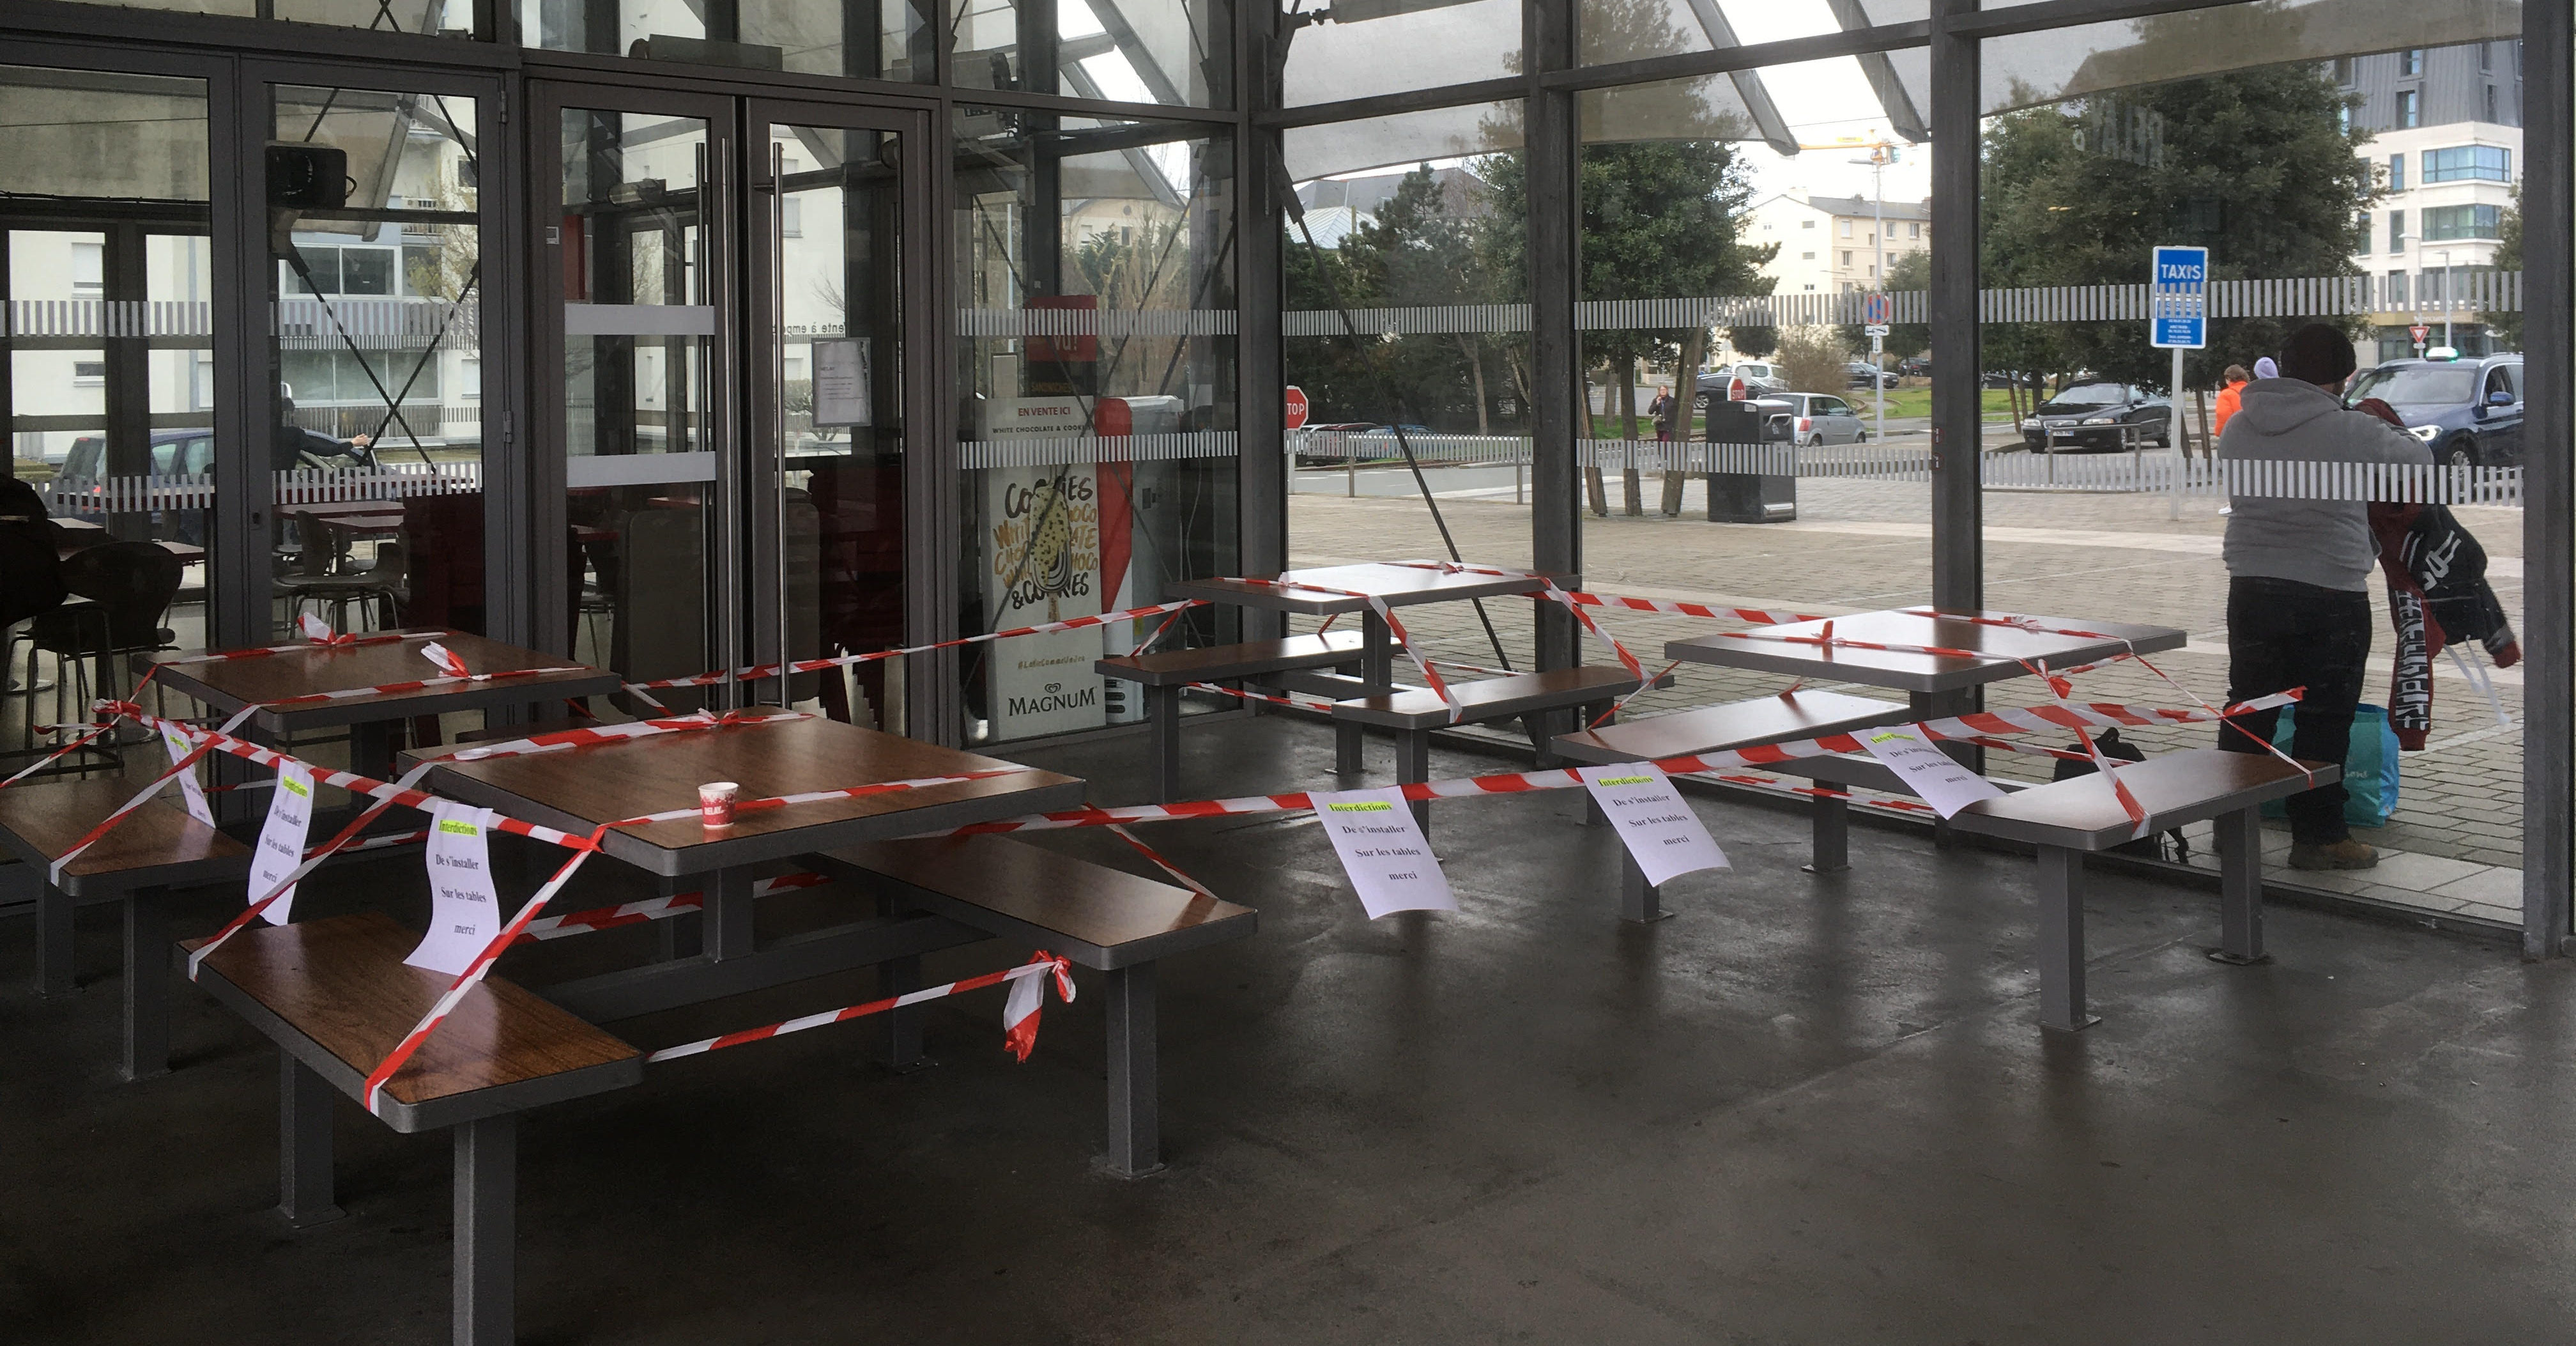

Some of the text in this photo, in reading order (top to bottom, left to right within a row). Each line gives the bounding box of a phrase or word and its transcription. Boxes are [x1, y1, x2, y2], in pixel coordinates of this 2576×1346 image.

[2161, 264, 2202, 279] TAXIS
[1732, 390, 1745, 399] STOP
[1018, 406, 1071, 416] EN VENTE ICI
[1287, 403, 1305, 415] TOP
[1008, 687, 1095, 716] MAGNUM
[1909, 764, 1925, 773] Sur
[1598, 776, 1653, 787] Interdictions
[1328, 802, 1393, 812] Interdictions
[1613, 798, 1627, 807] De
[1629, 814, 1689, 828] Sur les tables
[1342, 825, 1356, 834] De
[1663, 835, 1690, 846] merci
[1355, 847, 1421, 858] Sur les tables
[436, 854, 445, 865] De
[1389, 870, 1418, 881] merci
[441, 886, 487, 903] Sur les tables
[454, 924, 475, 936] merci
